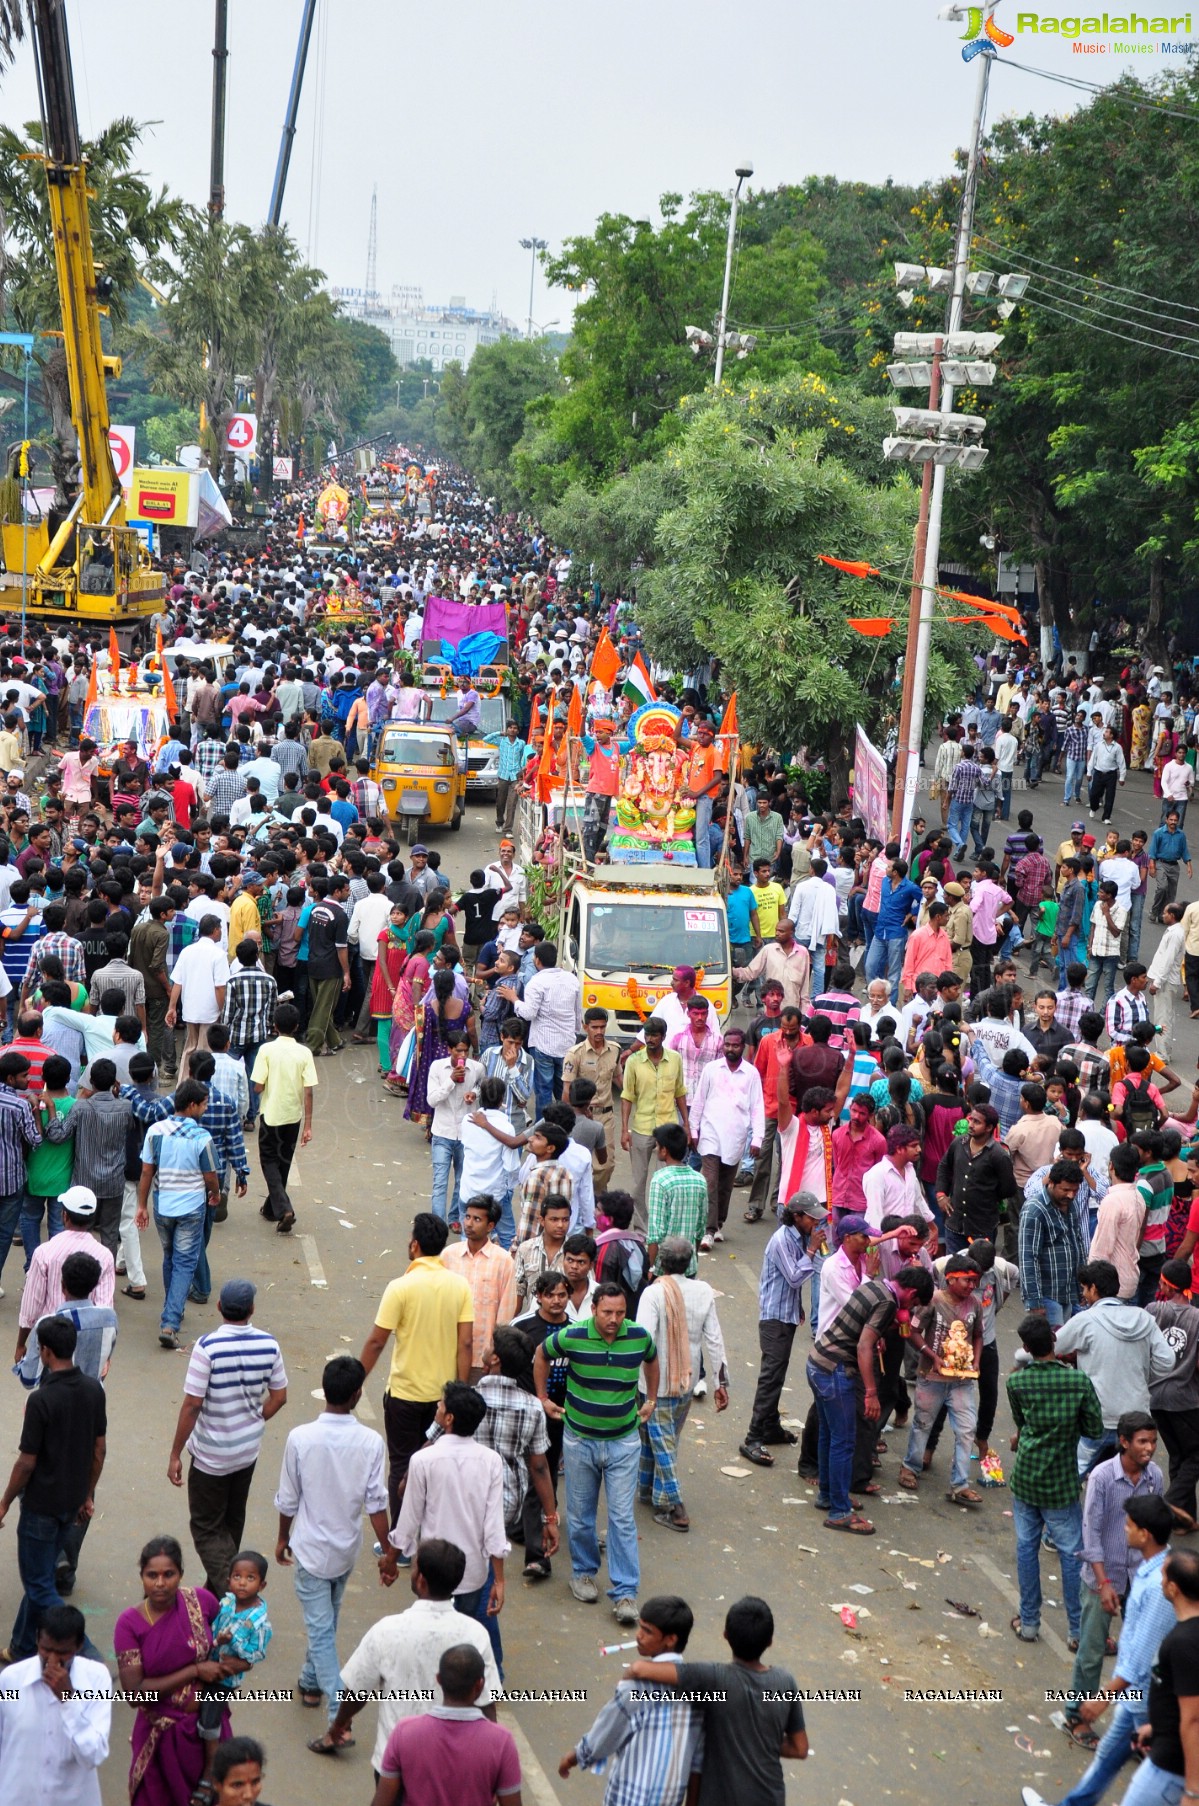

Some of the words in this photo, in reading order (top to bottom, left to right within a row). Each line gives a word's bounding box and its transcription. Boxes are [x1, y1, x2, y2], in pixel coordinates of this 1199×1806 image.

[229, 420, 248, 443] 4
[473, 902, 482, 918] 1
[621, 989, 648, 998] GDS
